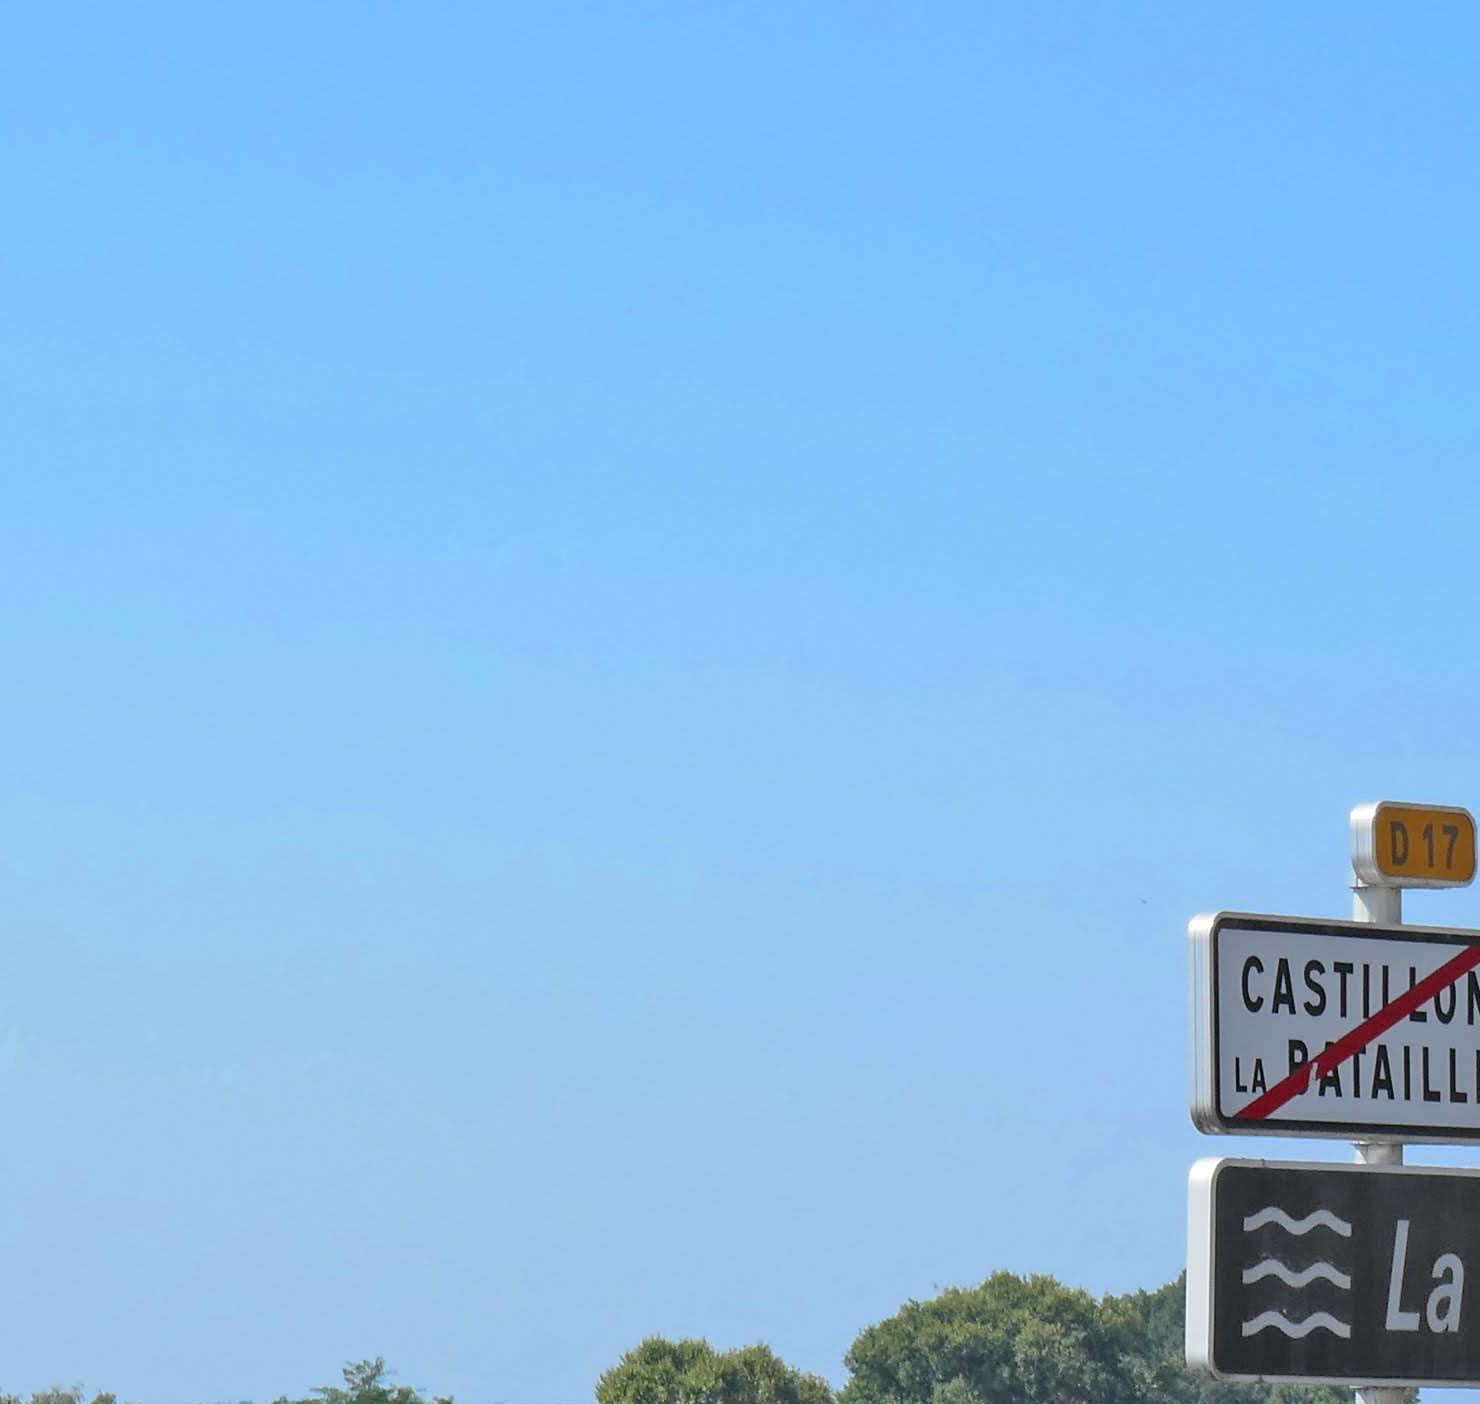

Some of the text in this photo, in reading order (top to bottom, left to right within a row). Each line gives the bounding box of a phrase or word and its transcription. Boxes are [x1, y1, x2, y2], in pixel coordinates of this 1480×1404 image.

[1390, 821, 1459, 870] D 17
[1235, 1057, 1267, 1094] LA
[1385, 1219, 1465, 1334] La
